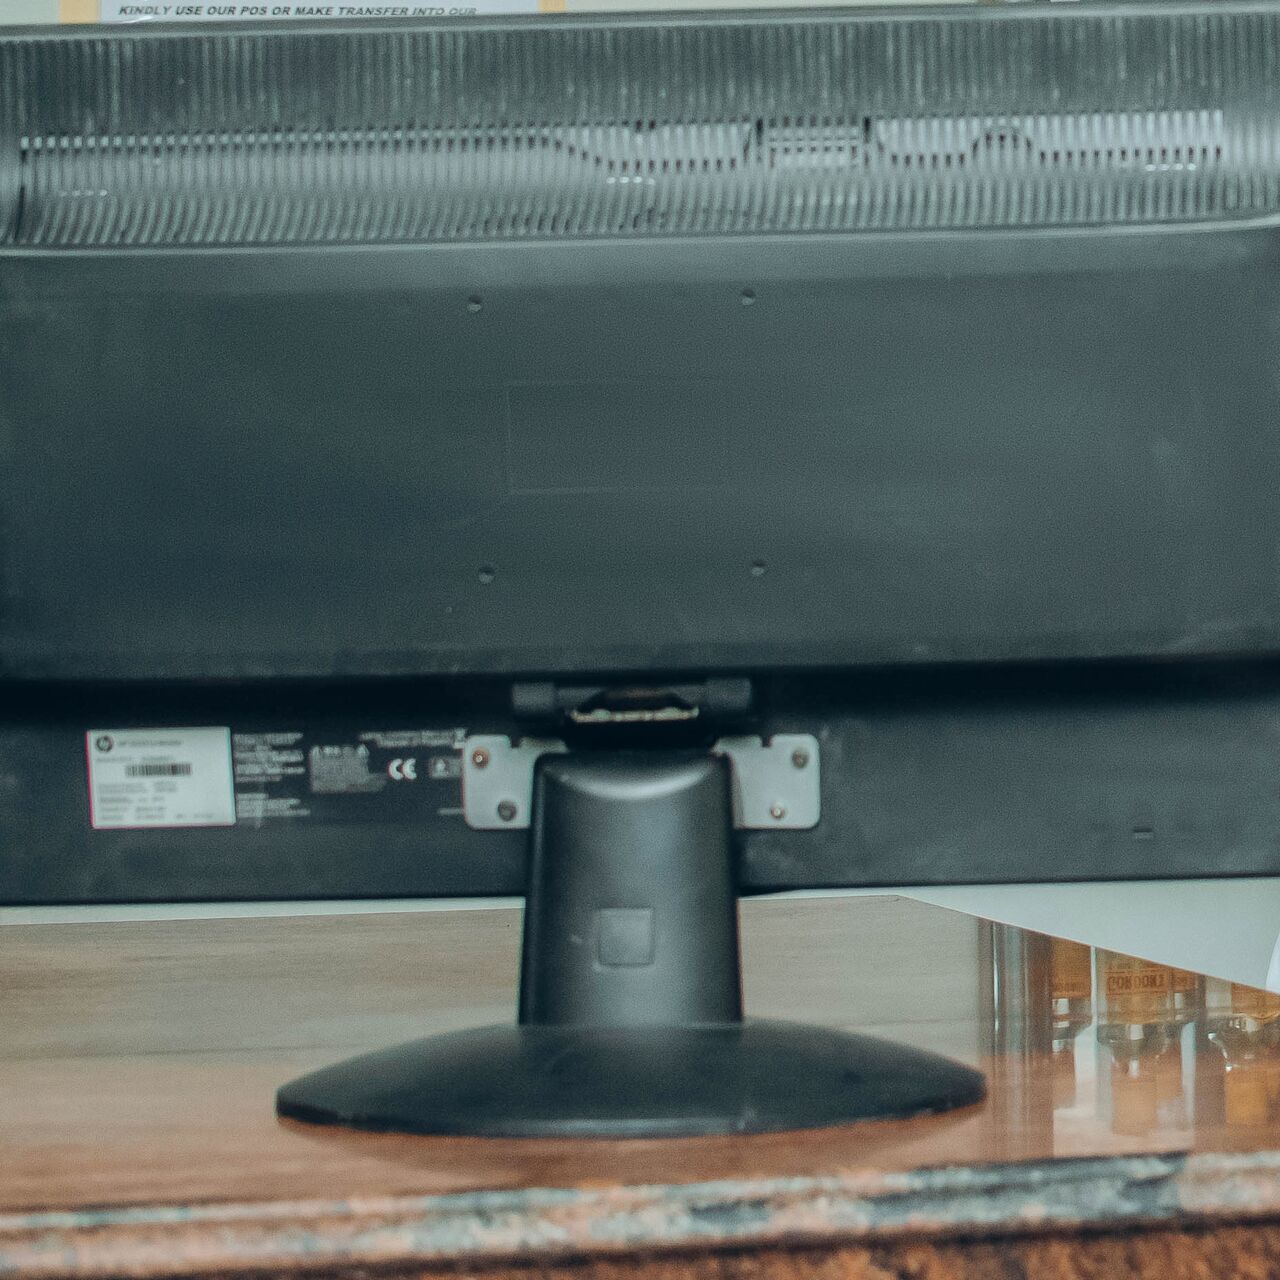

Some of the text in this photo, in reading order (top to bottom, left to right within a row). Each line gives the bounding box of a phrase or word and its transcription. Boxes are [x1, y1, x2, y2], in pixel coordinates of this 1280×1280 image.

[118, 5, 171, 16] KINDLY
[175, 5, 202, 16] USE
[207, 5, 236, 16] OUR
[240, 5, 267, 16] POS
[272, 6, 290, 16] OR
[295, 6, 333, 16] MAKE
[338, 6, 408, 17] TRANSFER
